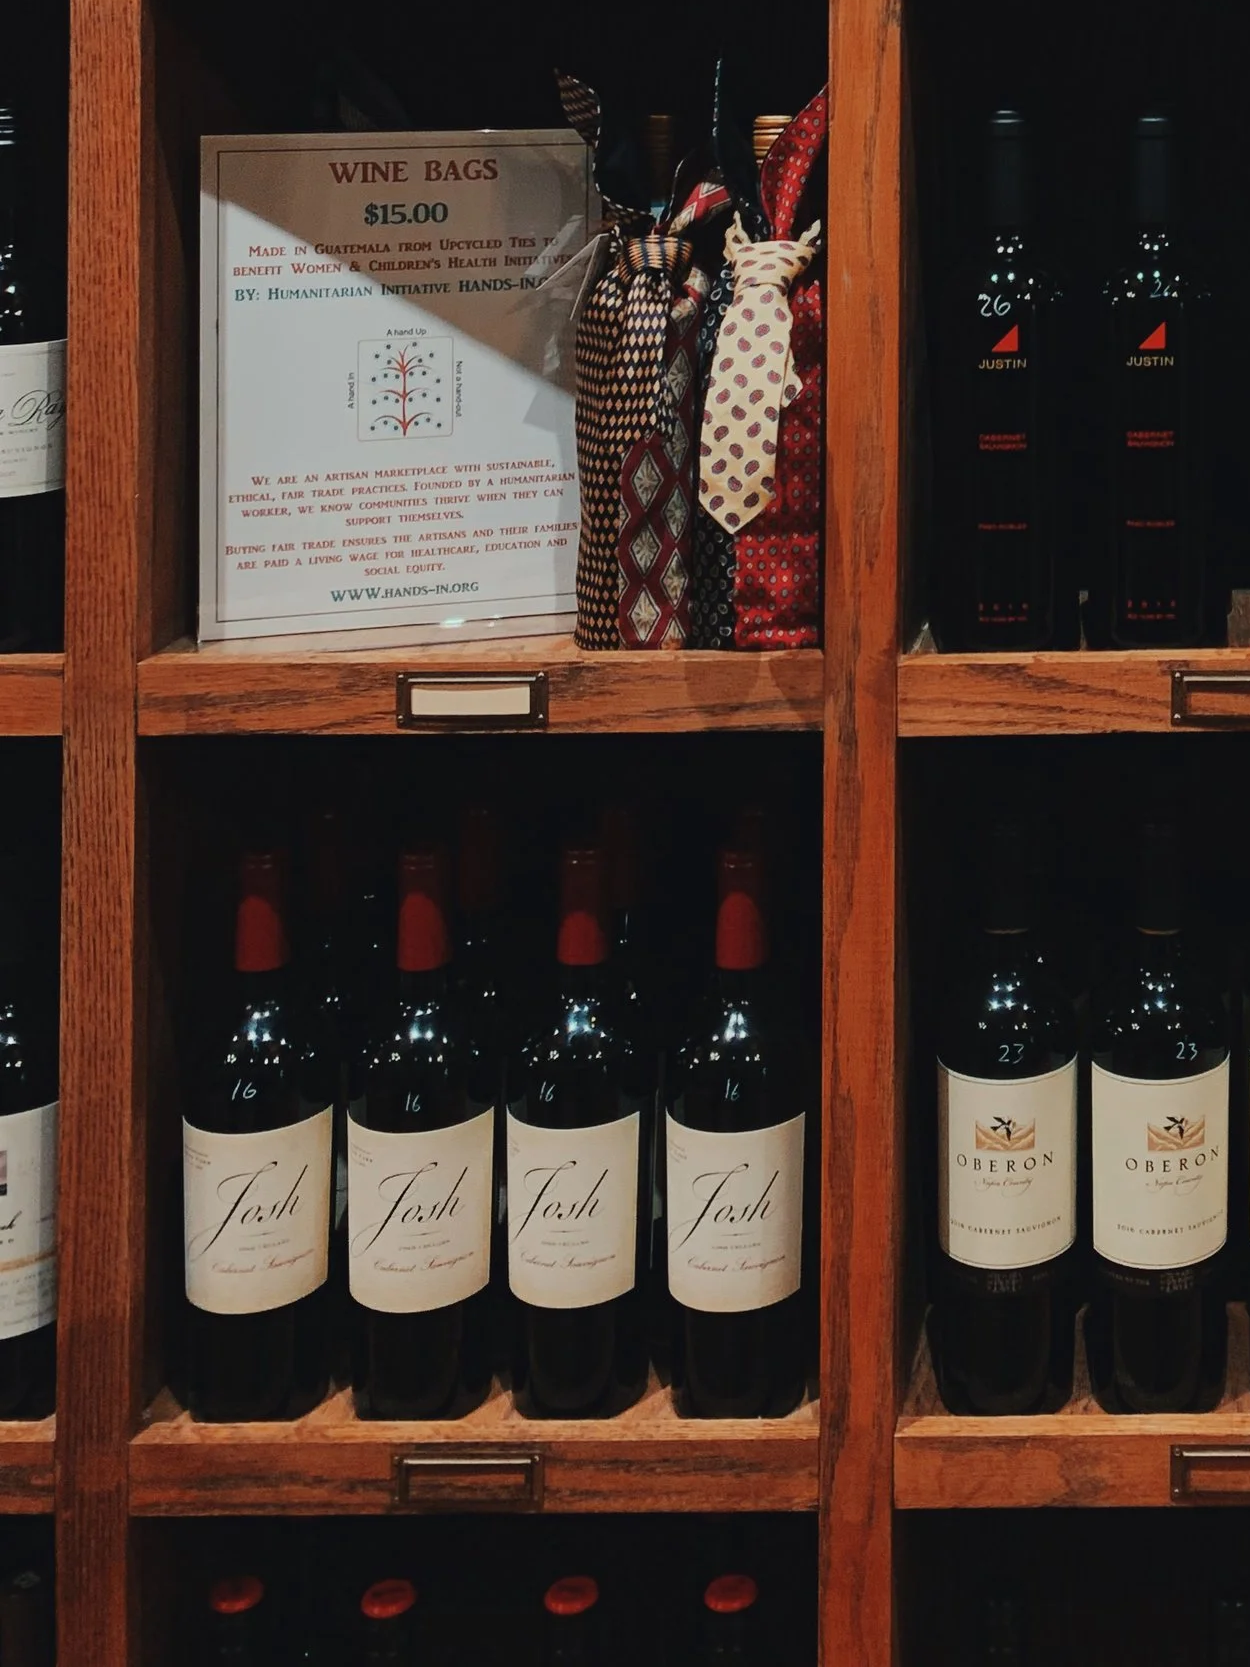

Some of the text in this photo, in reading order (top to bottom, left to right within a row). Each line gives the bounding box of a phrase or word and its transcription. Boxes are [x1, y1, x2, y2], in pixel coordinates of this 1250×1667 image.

[328, 159, 499, 183] WINE BAGS
[363, 202, 449, 225] $15.00
[294, 246, 307, 255] IN
[314, 243, 390, 255] GUATEMALA
[290, 262, 342, 274] WOMEN
[349, 261, 361, 272] &
[448, 256, 497, 269] HEALTH
[234, 288, 260, 302] BY:
[268, 285, 373, 300] HUMANITARIAN
[381, 282, 451, 296] INITIATIVE
[978, 294, 1012, 318] 26
[394, 328, 413, 336] hand
[415, 328, 427, 336] Up
[978, 357, 1027, 370] JUSTIN
[1126, 355, 1174, 367] JUSTIN
[998, 1043, 1024, 1064] 23
[1176, 1041, 1198, 1060] 23
[231, 1079, 257, 1100] 16
[539, 1081, 556, 1102] 16
[725, 1079, 740, 1101] 16
[405, 1092, 421, 1112] 16
[956, 1151, 1054, 1173] OBERON
[1125, 1146, 1219, 1173] OBERON
[187, 1161, 308, 1263] Josh
[351, 1161, 468, 1259] Josh
[509, 1160, 608, 1247] Josh
[669, 1163, 779, 1254] Josh
